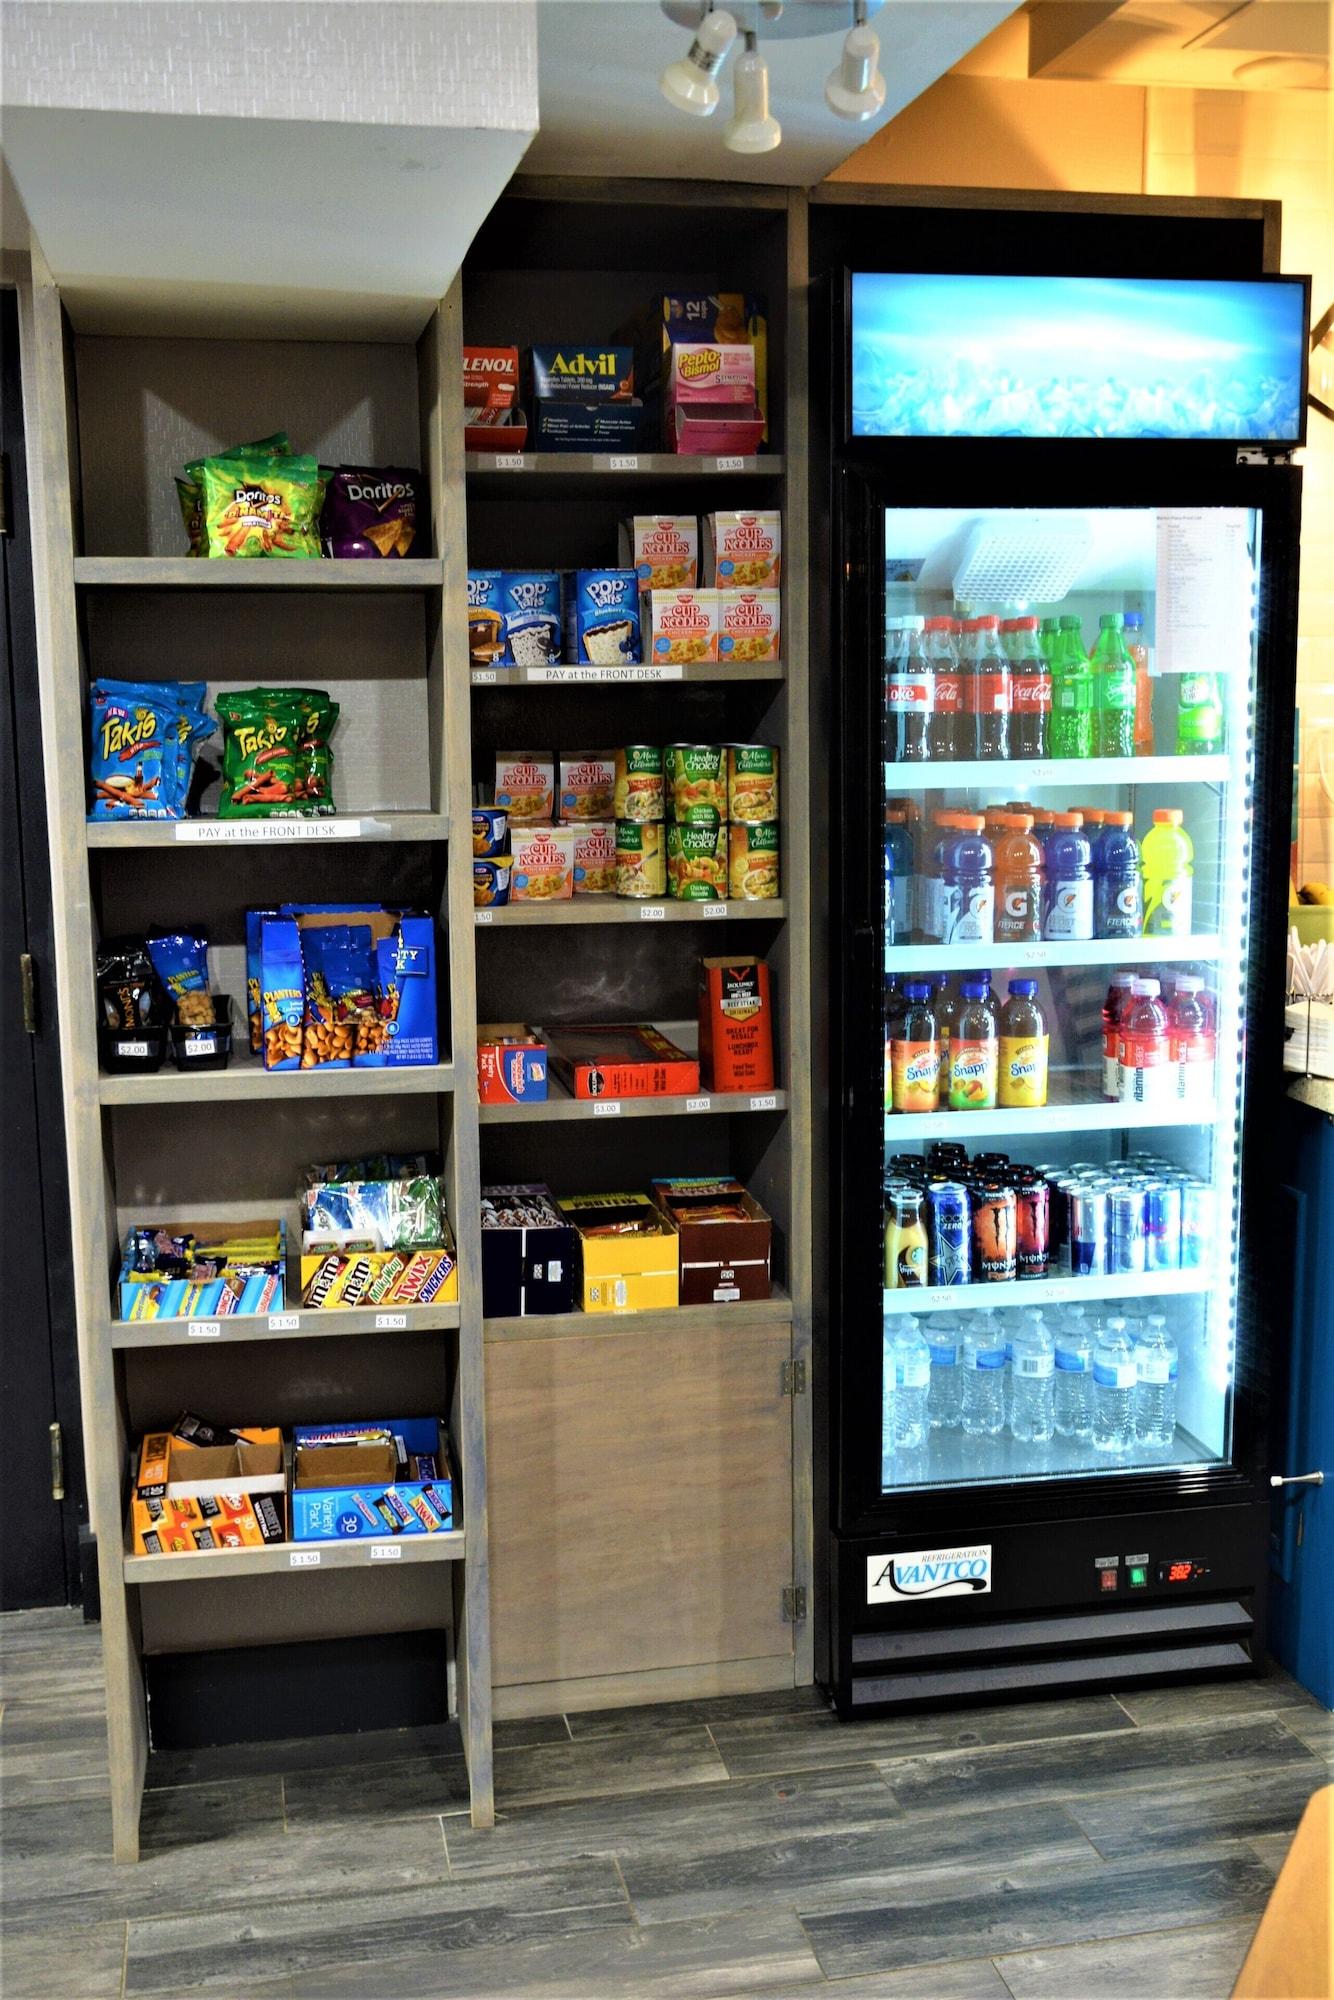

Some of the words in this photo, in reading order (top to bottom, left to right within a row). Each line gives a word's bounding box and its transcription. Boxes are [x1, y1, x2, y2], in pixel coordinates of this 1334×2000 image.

[549, 353, 616, 375] Advil
[683, 361, 721, 378] Bismol
[236, 490, 282, 505] Doritos
[347, 482, 415, 501] Doritos
[653, 532, 680, 543] CUP
[736, 528, 763, 540] CUP
[643, 542, 689, 555] NOODLES
[724, 538, 772, 551] NOODLES
[672, 605, 700, 616] CUP
[735, 605, 762, 616] CUP
[660, 615, 710, 628] NOODLES
[724, 615, 772, 628] NOODLES
[493, 653, 499, 662] 8
[626, 651, 633, 660] 8
[546, 670, 565, 680] PAY
[568, 671, 578, 679] at
[581, 670, 597, 679] the
[600, 669, 635, 680] FRONT
[637, 669, 662, 679] DESK
[102, 711, 157, 761] Takis
[689, 752, 720, 763] Healthy
[513, 765, 538, 776] CUP
[578, 764, 604, 776] CUP
[685, 760, 719, 770] Choice
[503, 774, 546, 786] NOODLES
[568, 774, 612, 786] NOODLES
[198, 827, 221, 838] PAY
[225, 828, 237, 837] at
[240, 826, 259, 837] the
[263, 825, 301, 837] FRONT
[306, 825, 336, 836] DESK
[687, 830, 717, 841] Healthy
[530, 843, 557, 855] CUP
[587, 838, 613, 849] CUP
[683, 838, 716, 848] Choice
[519, 853, 566, 866] NOODLES
[1006, 891, 1028, 917] G
[642, 908, 663, 917] $2.00
[705, 907, 725, 915] $2.00
[263, 988, 302, 1003] PLANTERS
[120, 1046, 146, 1054] $2.00
[187, 1044, 212, 1053] $2.00
[595, 1105, 616, 1113] $3.00
[688, 1100, 709, 1109] $2.00
[419, 1255, 453, 1303] SNICKERS
[279, 1318, 297, 1327] 1.50
[387, 1317, 404, 1326] 1.50
[199, 1325, 217, 1334] 1.50
[309, 1503, 322, 1529] Pack
[322, 1496, 335, 1535] Variety
[243, 1516, 256, 1530] 30
[342, 1516, 357, 1533] 30
[922, 1548, 988, 1563] REFRIGERATION
[871, 1558, 988, 1591] AVANTCO
